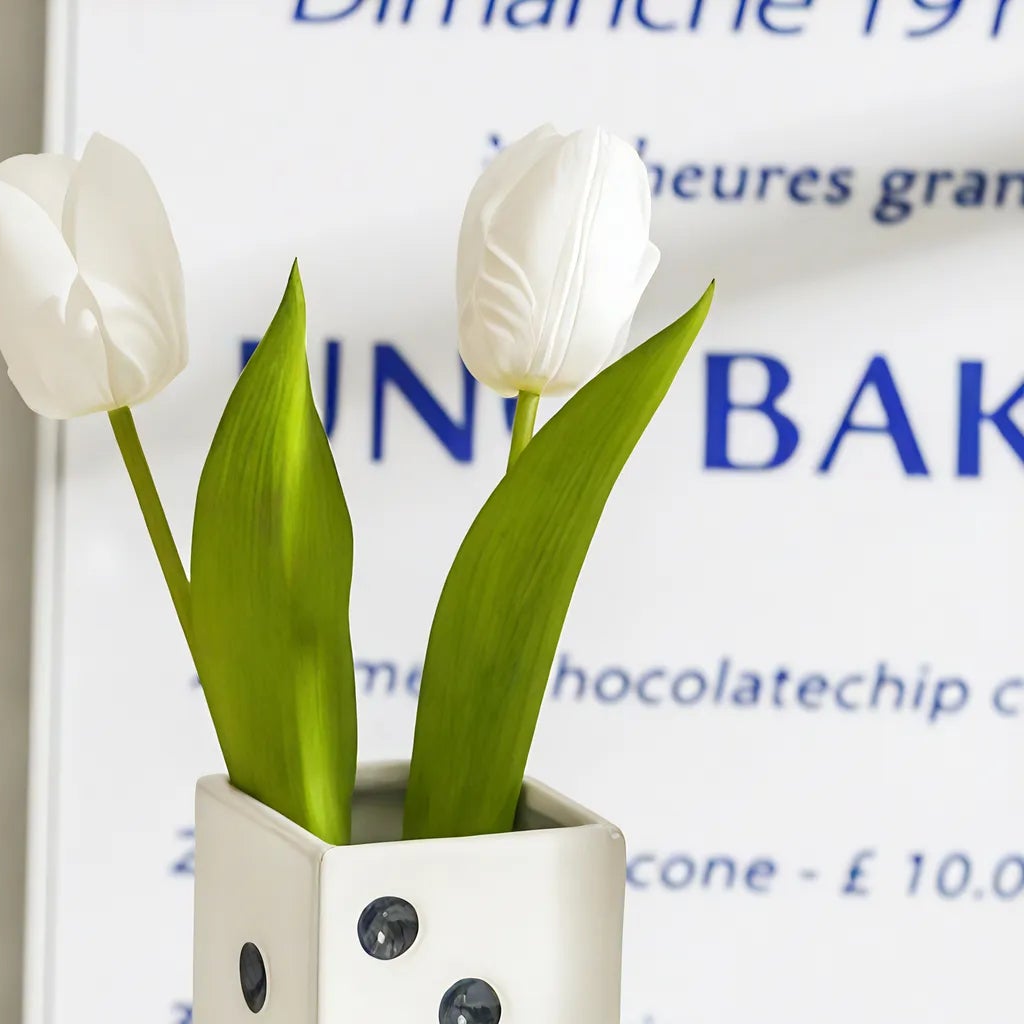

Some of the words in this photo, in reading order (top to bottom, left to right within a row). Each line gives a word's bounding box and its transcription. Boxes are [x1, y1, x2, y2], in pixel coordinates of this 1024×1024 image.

[700, 348, 1024, 481] BAK
[551, 653, 970, 723] hocolatechip
[841, 850, 874, 896] £
